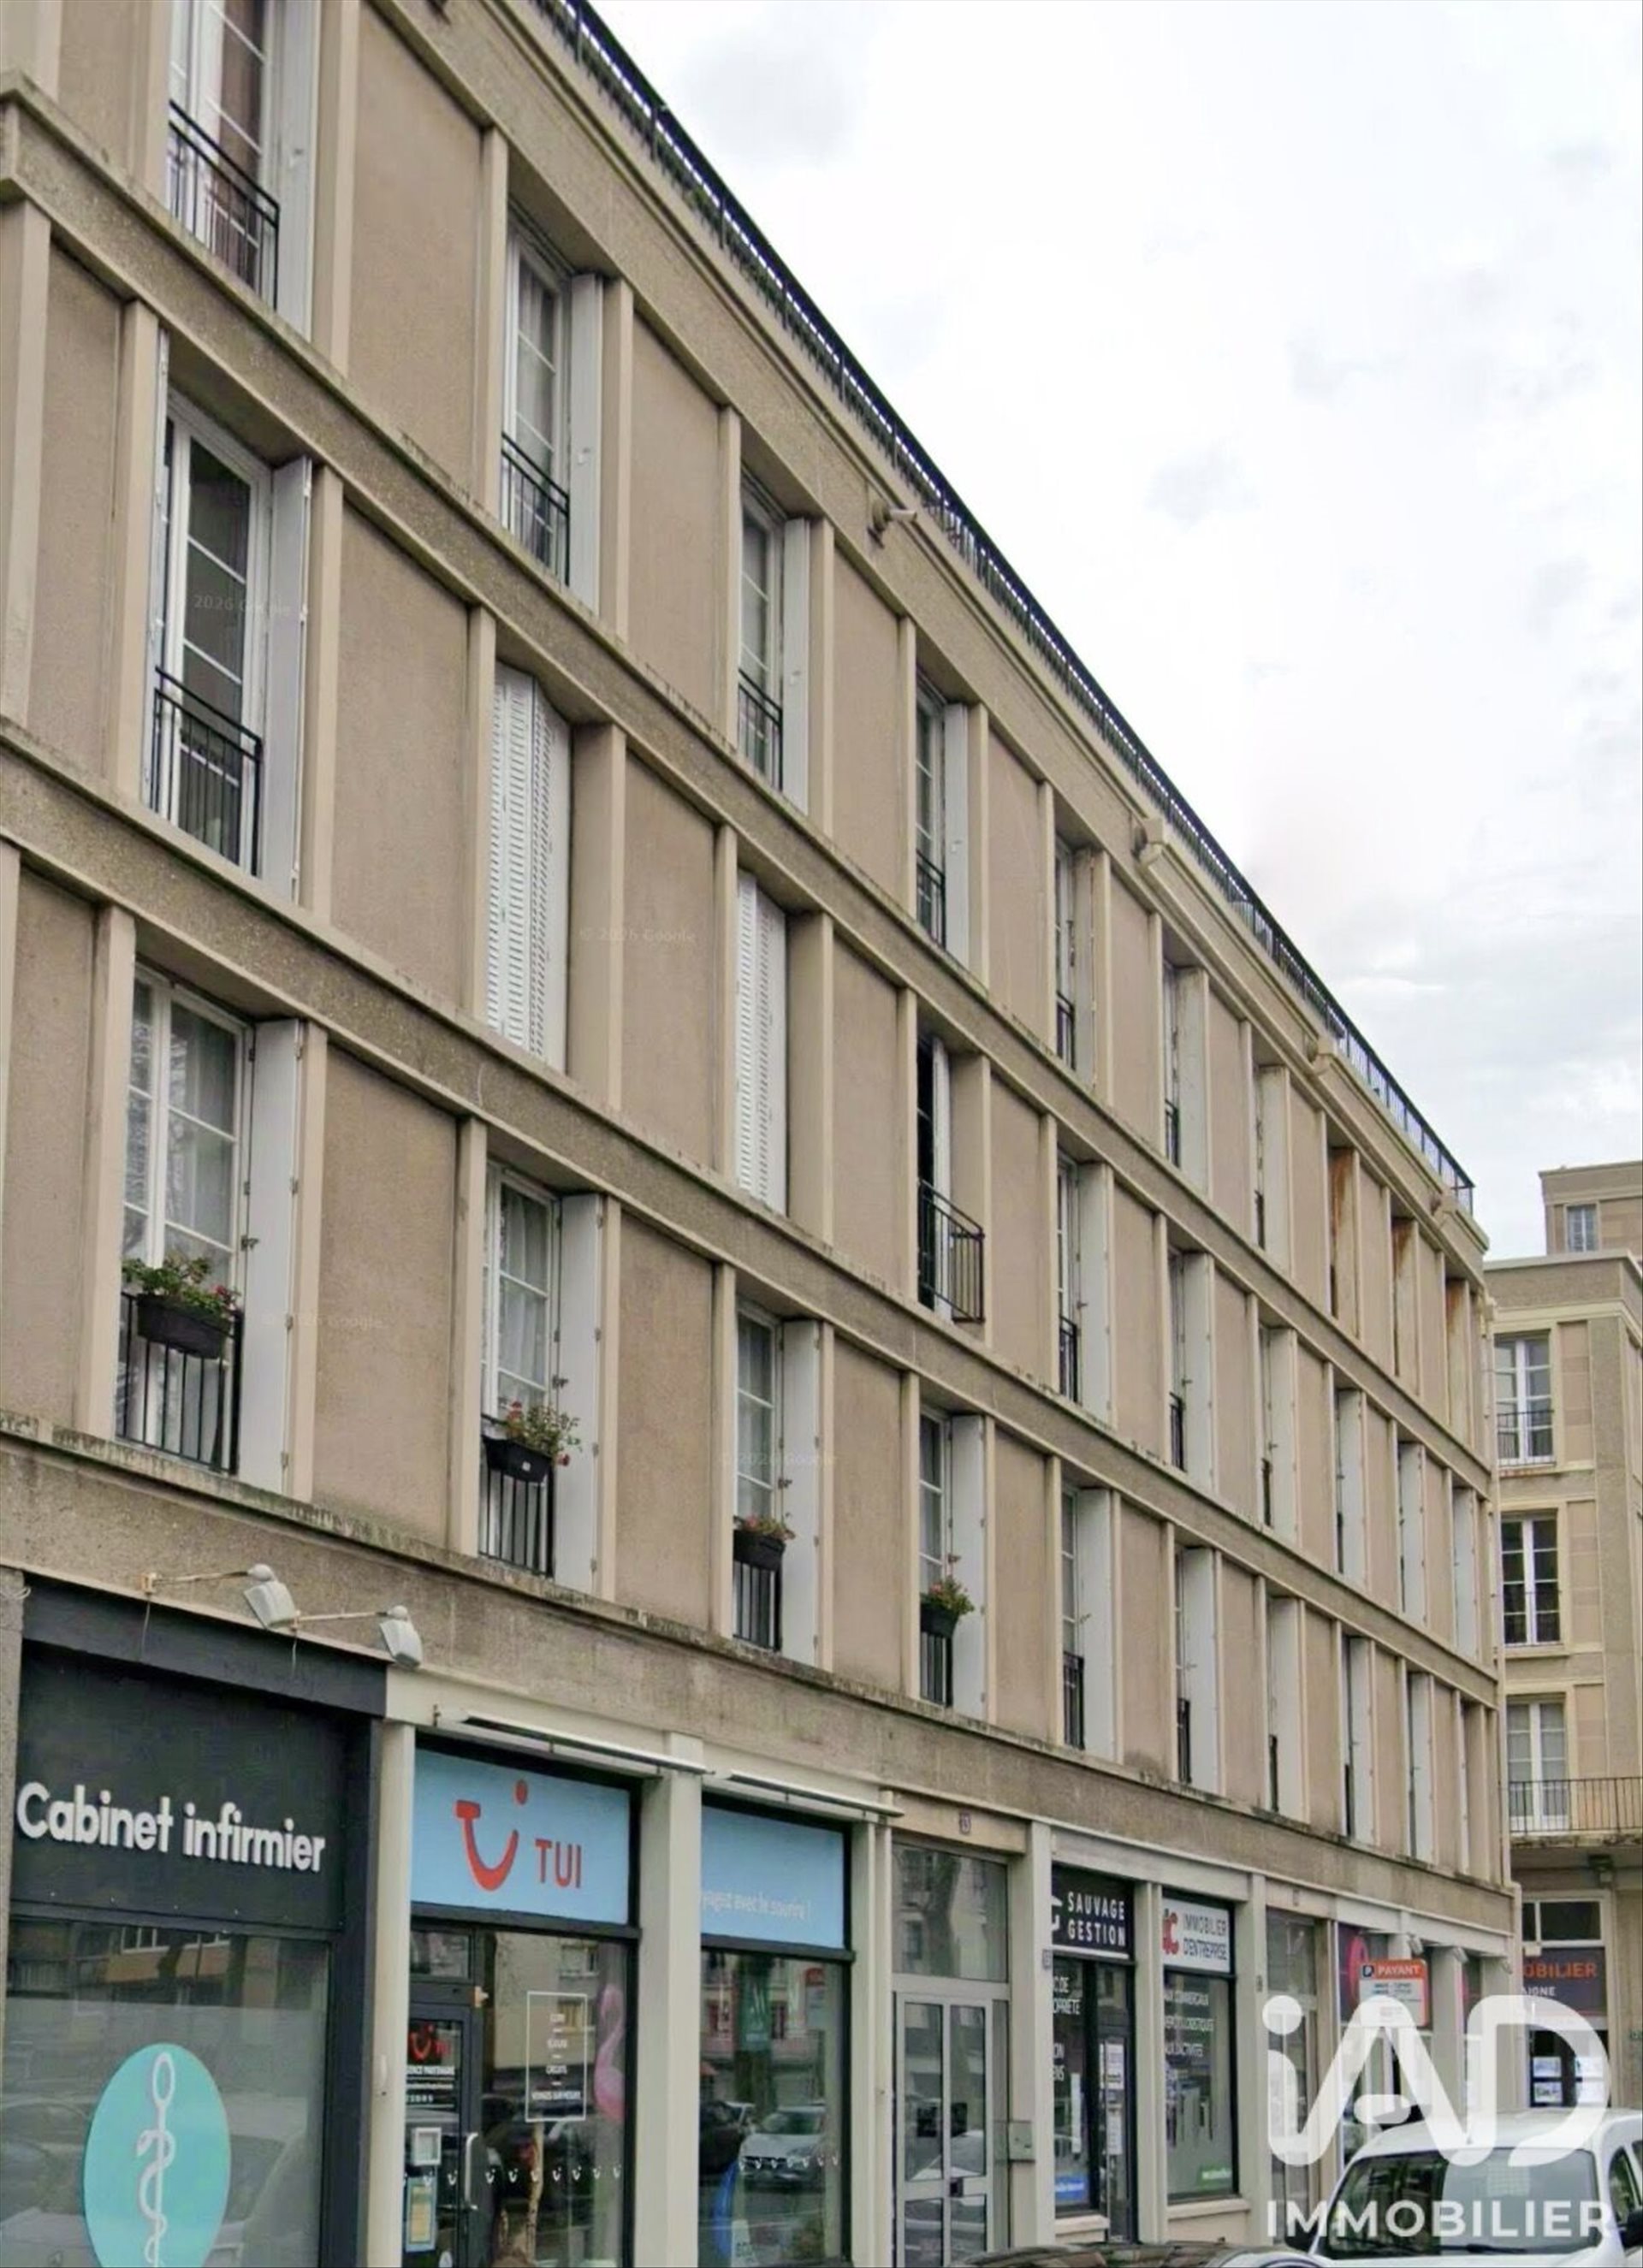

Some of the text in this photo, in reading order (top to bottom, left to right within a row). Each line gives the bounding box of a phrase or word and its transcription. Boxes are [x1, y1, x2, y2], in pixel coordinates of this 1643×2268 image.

[16, 1781, 326, 1872] Cabinet infirmier
[535, 1838, 583, 1889] TUI
[1068, 1891, 1125, 1921] SAUVAGE
[1068, 1919, 1126, 1947] GESTION
[1183, 1913, 1226, 1936] IMMOBILIER
[1378, 1963, 1420, 1976] PAYANT
